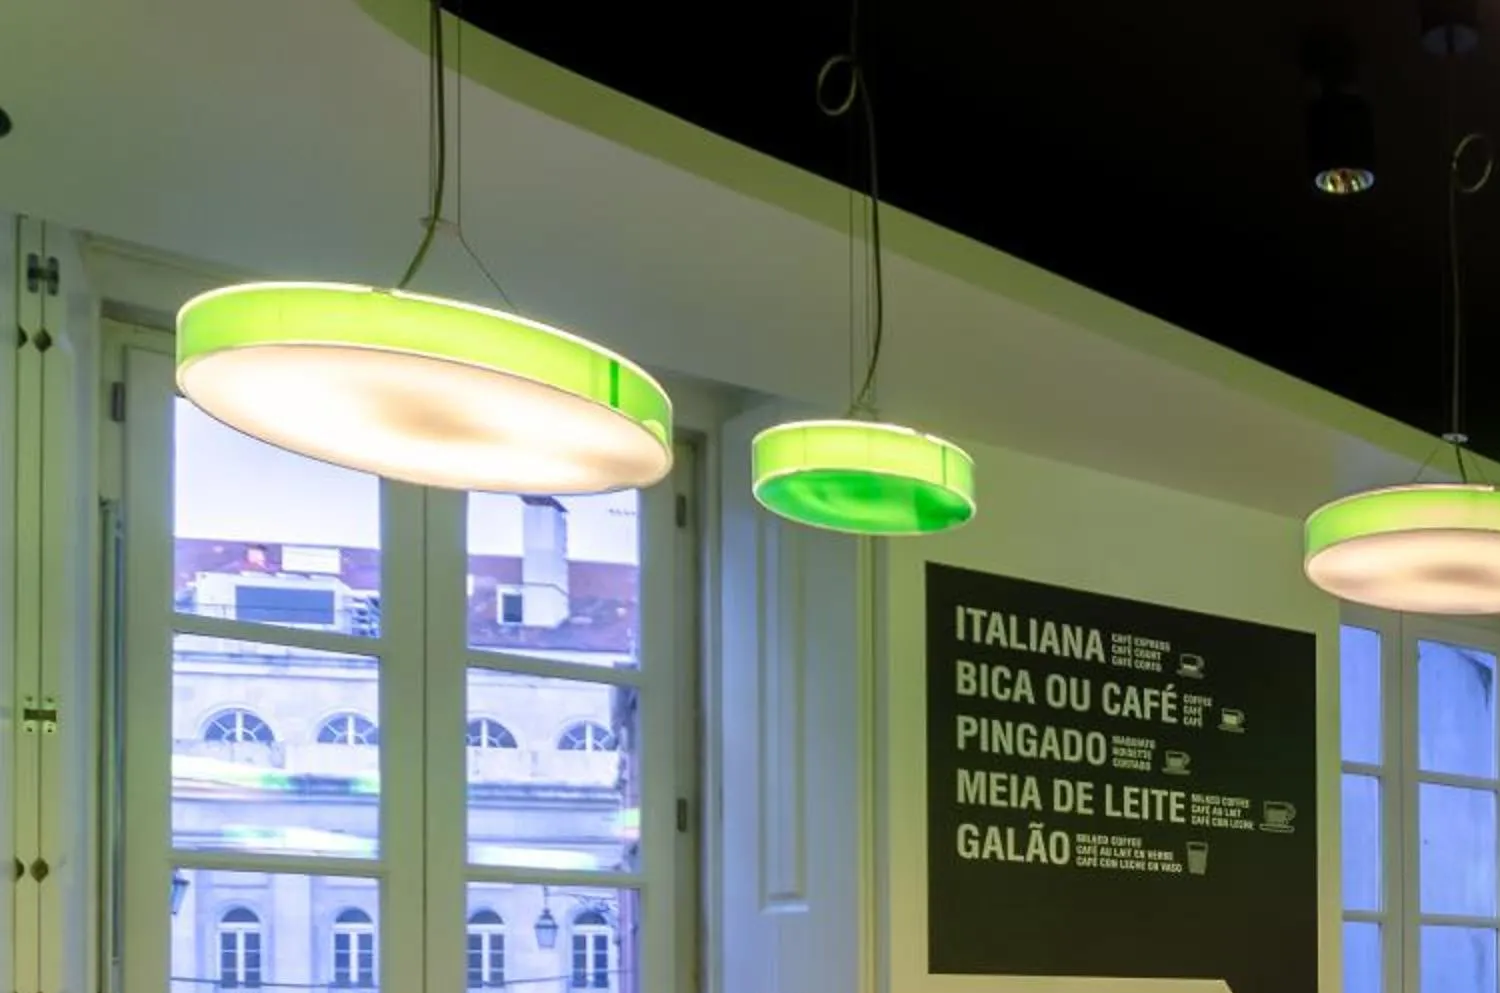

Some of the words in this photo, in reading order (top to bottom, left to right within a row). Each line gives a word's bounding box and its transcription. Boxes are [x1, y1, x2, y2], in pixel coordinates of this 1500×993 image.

[956, 605, 1106, 663] ITALIANA
[956, 659, 1036, 705] BICA
[1045, 673, 1091, 712] OU
[1102, 683, 1178, 724] CAFÉ
[956, 714, 1107, 766] PINGADO
[956, 767, 1043, 811] MEIA
[1052, 778, 1095, 816] DE
[1104, 783, 1187, 824] LEITE
[956, 822, 1071, 866] GALÃO
